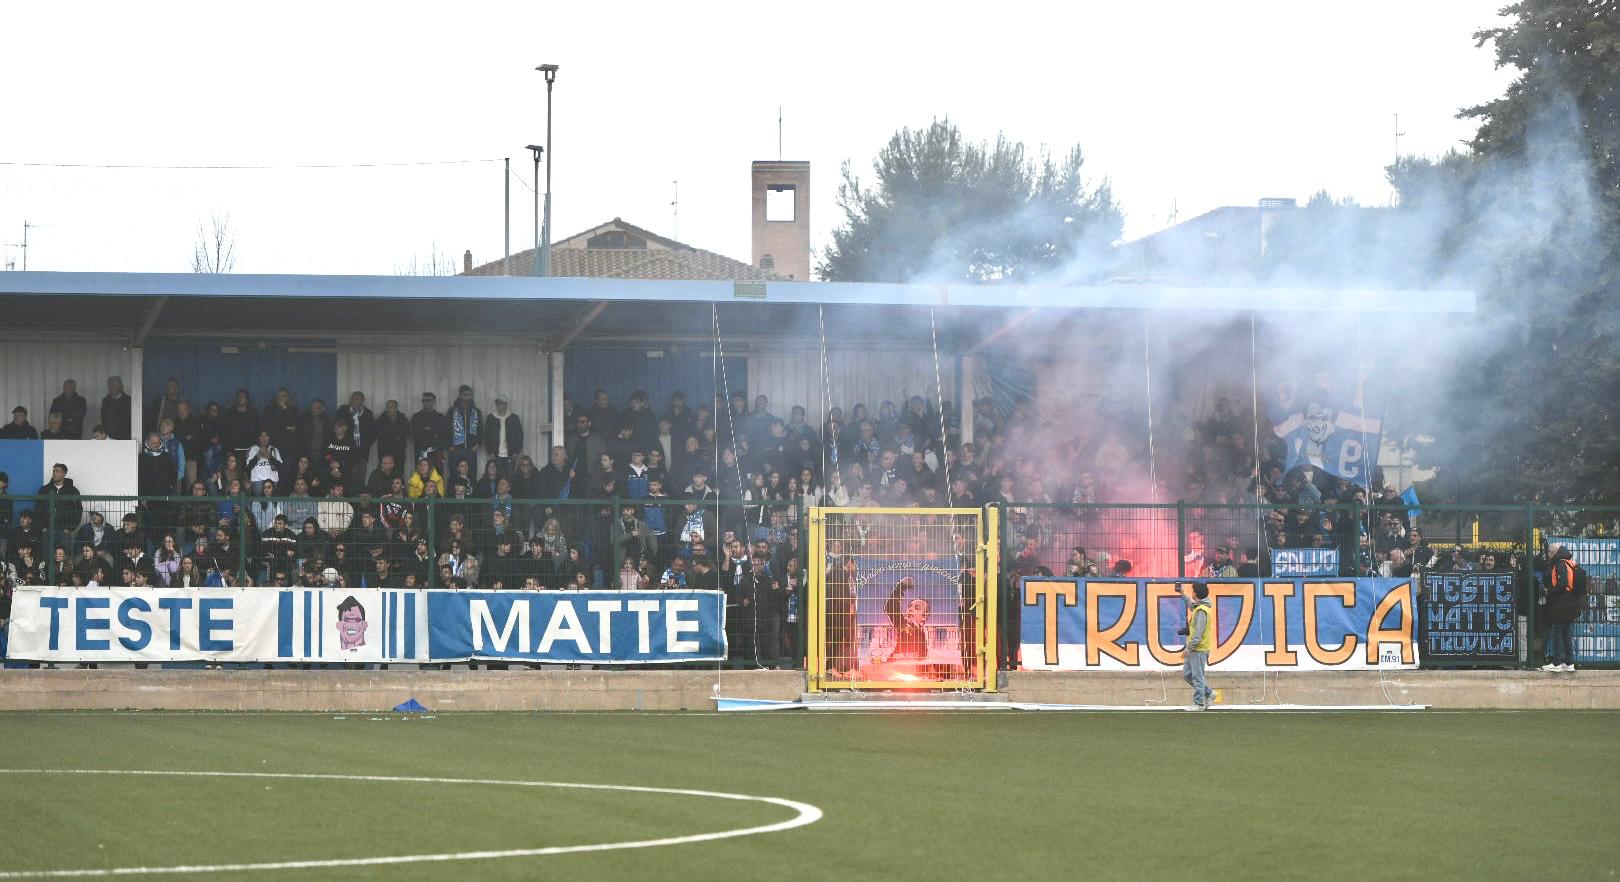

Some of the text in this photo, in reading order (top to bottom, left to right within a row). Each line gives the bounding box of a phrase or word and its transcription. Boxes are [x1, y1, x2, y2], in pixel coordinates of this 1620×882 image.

[1427, 576, 1512, 602] TESTE
[39, 596, 234, 652] TESTE
[469, 599, 700, 654] MATTE
[1024, 581, 1415, 667] TRODICA
[1427, 603, 1512, 630] MATTE
[1428, 632, 1513, 653] TRODICA
